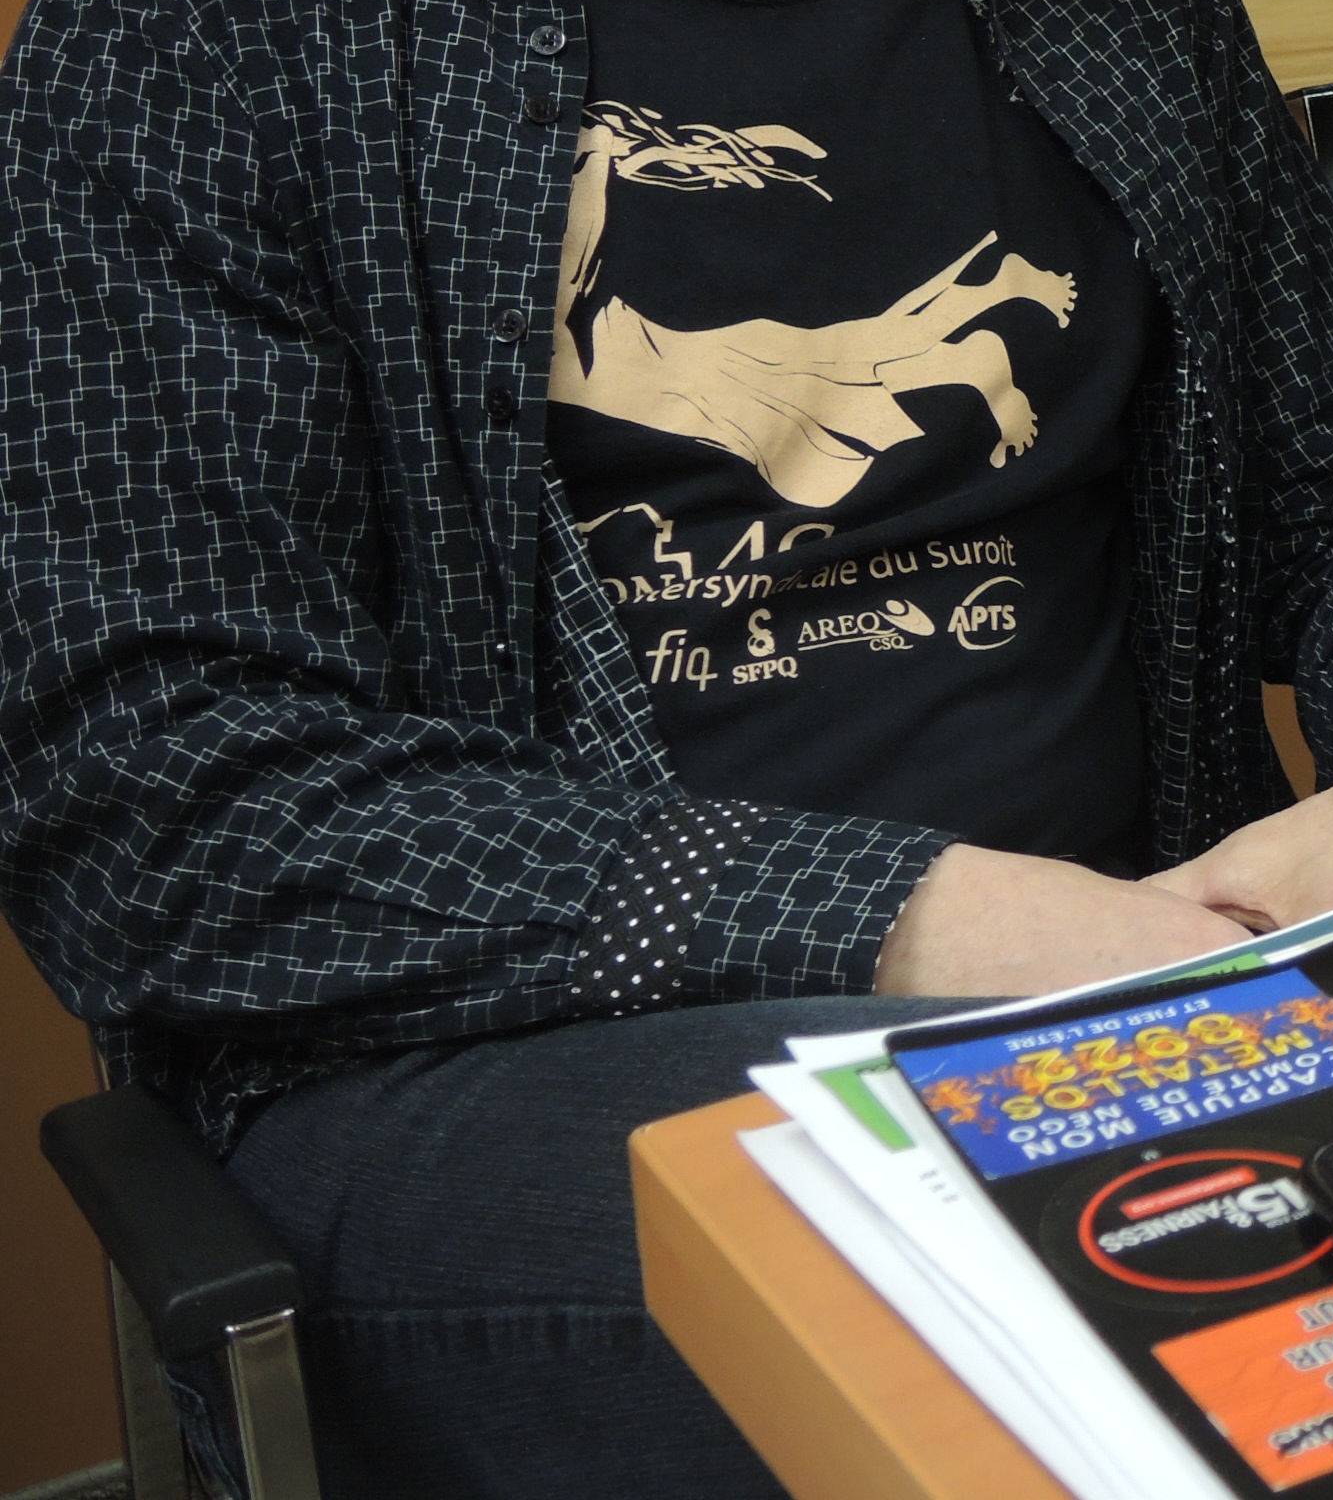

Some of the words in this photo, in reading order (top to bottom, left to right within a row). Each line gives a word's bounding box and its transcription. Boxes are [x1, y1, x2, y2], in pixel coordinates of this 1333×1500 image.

[869, 548, 919, 581] du
[927, 534, 1018, 570] Suroît
[798, 610, 897, 644] AREQ
[947, 604, 1017, 634] APTS
[869, 634, 914, 652] CSQ
[646, 628, 718, 692] fiq
[732, 655, 799, 686] SFPQ
[1127, 1006, 1177, 1027] FIER
[1183, 998, 1212, 1015] ET
[1092, 1019, 1122, 1036] DE
[1016, 1012, 1244, 1085] 8922
[1136, 1086, 1189, 1113] DE
[1020, 1116, 1138, 1161] MON
[1237, 1177, 1310, 1222] 15
[1098, 1195, 1243, 1253] FAIRNESS
